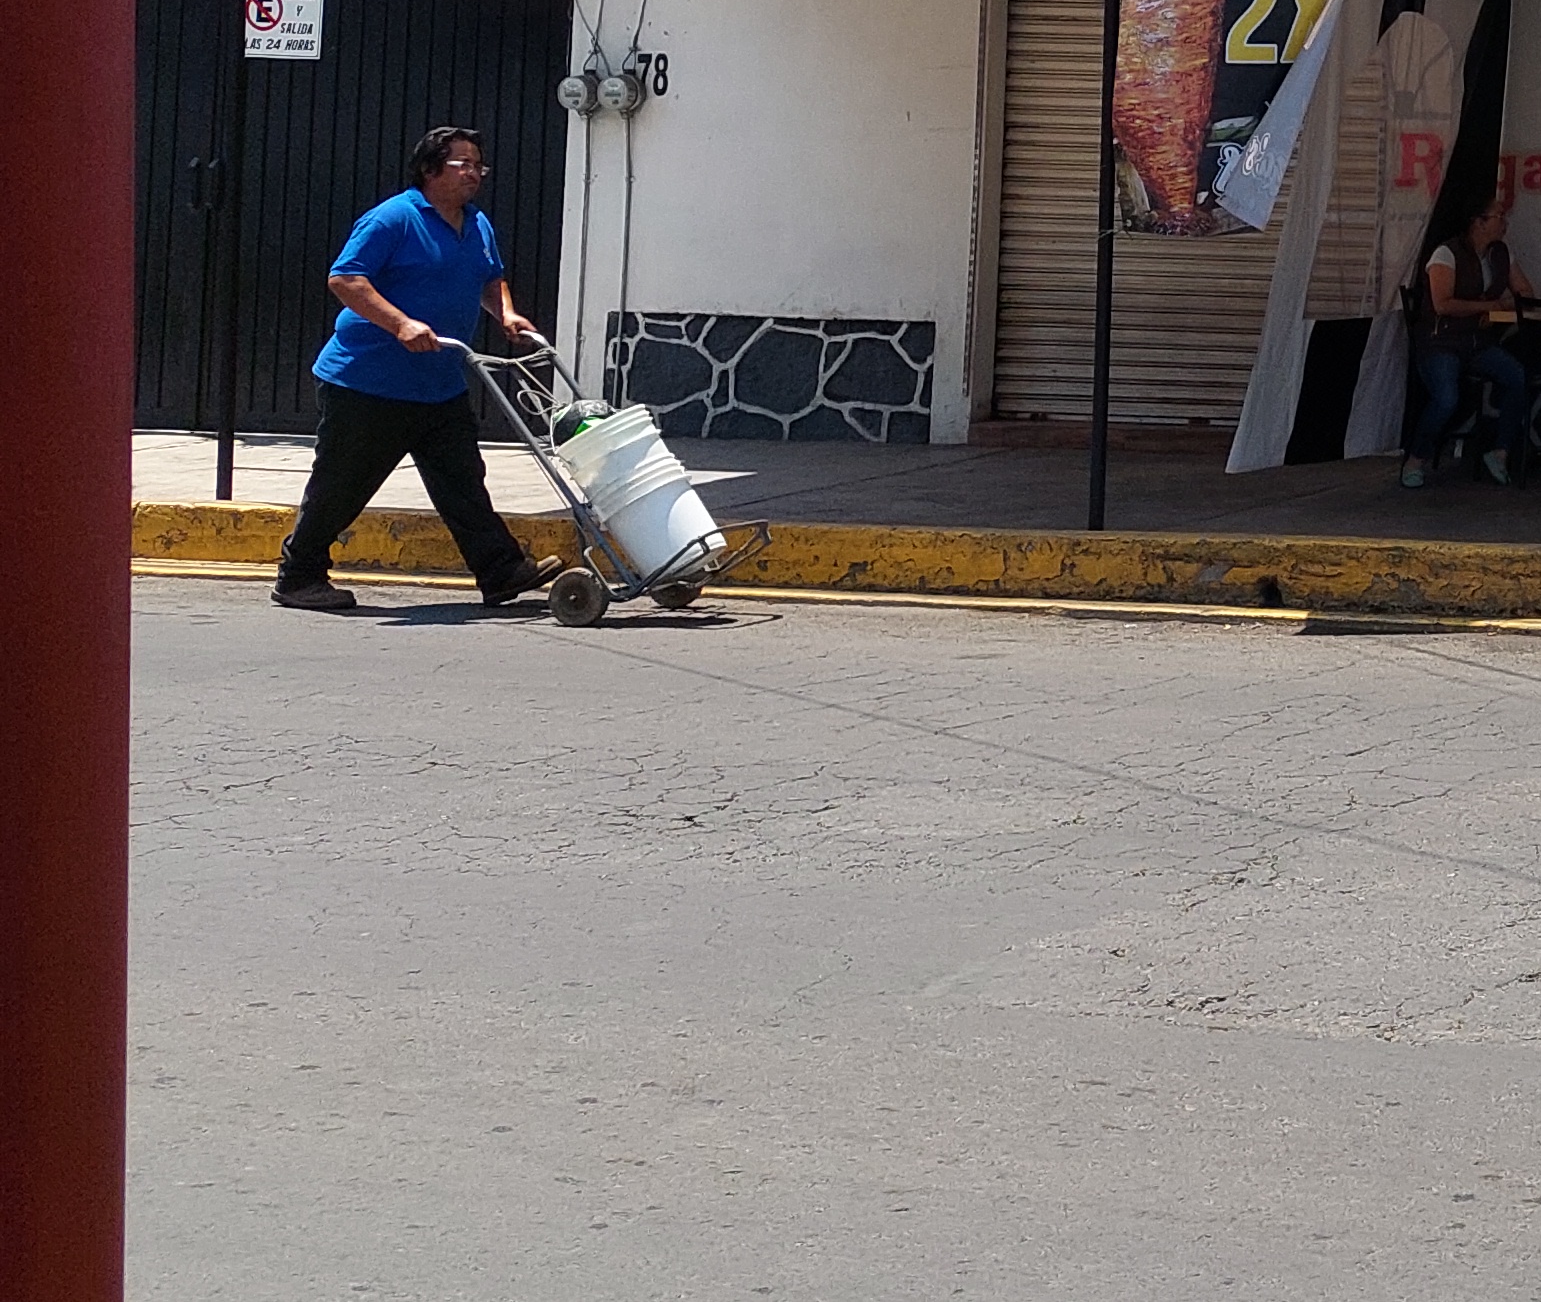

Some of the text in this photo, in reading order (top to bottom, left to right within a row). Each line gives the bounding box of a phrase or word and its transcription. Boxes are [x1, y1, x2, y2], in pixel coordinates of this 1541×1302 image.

[296, 5, 303, 16] Y
[280, 23, 314, 35] SALIDA
[245, 37, 316, 51] LAS 24 HORAS
[637, 53, 669, 96] 78
